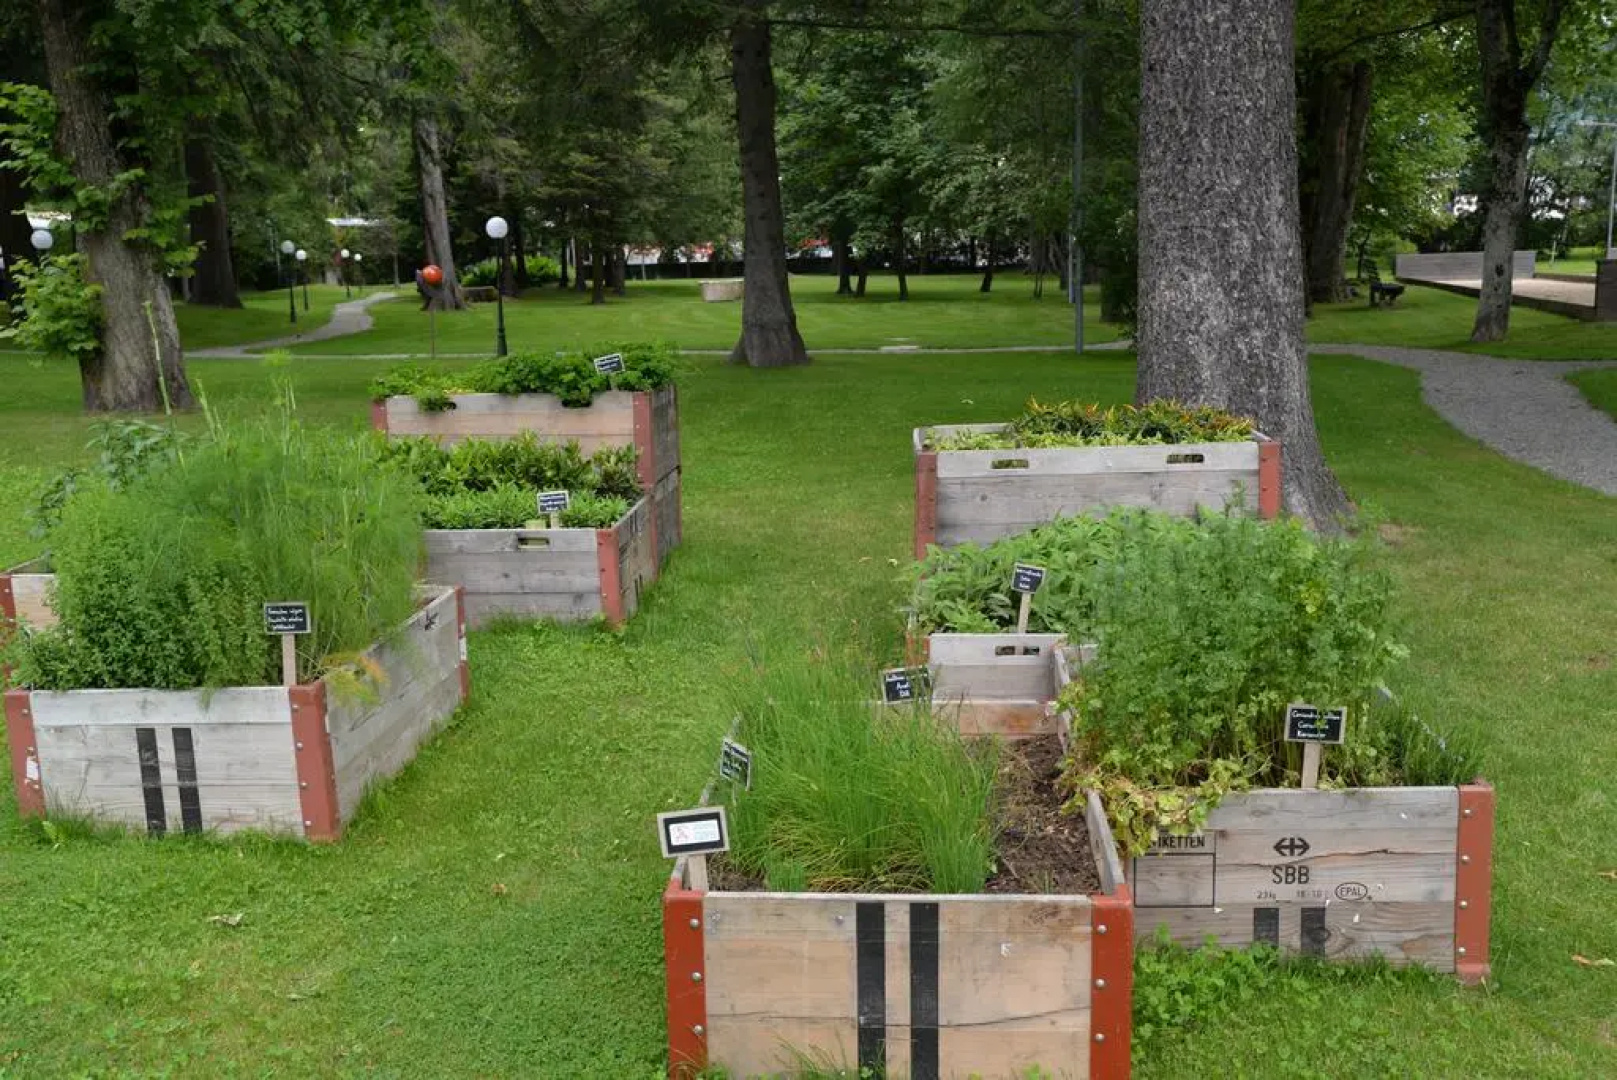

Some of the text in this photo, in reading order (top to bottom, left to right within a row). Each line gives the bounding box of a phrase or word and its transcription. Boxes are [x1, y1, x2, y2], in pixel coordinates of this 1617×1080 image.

[1148, 836, 1206, 849] IKETTEN
[1272, 864, 1310, 885] SBB
[1339, 885, 1363, 896] EPAL
